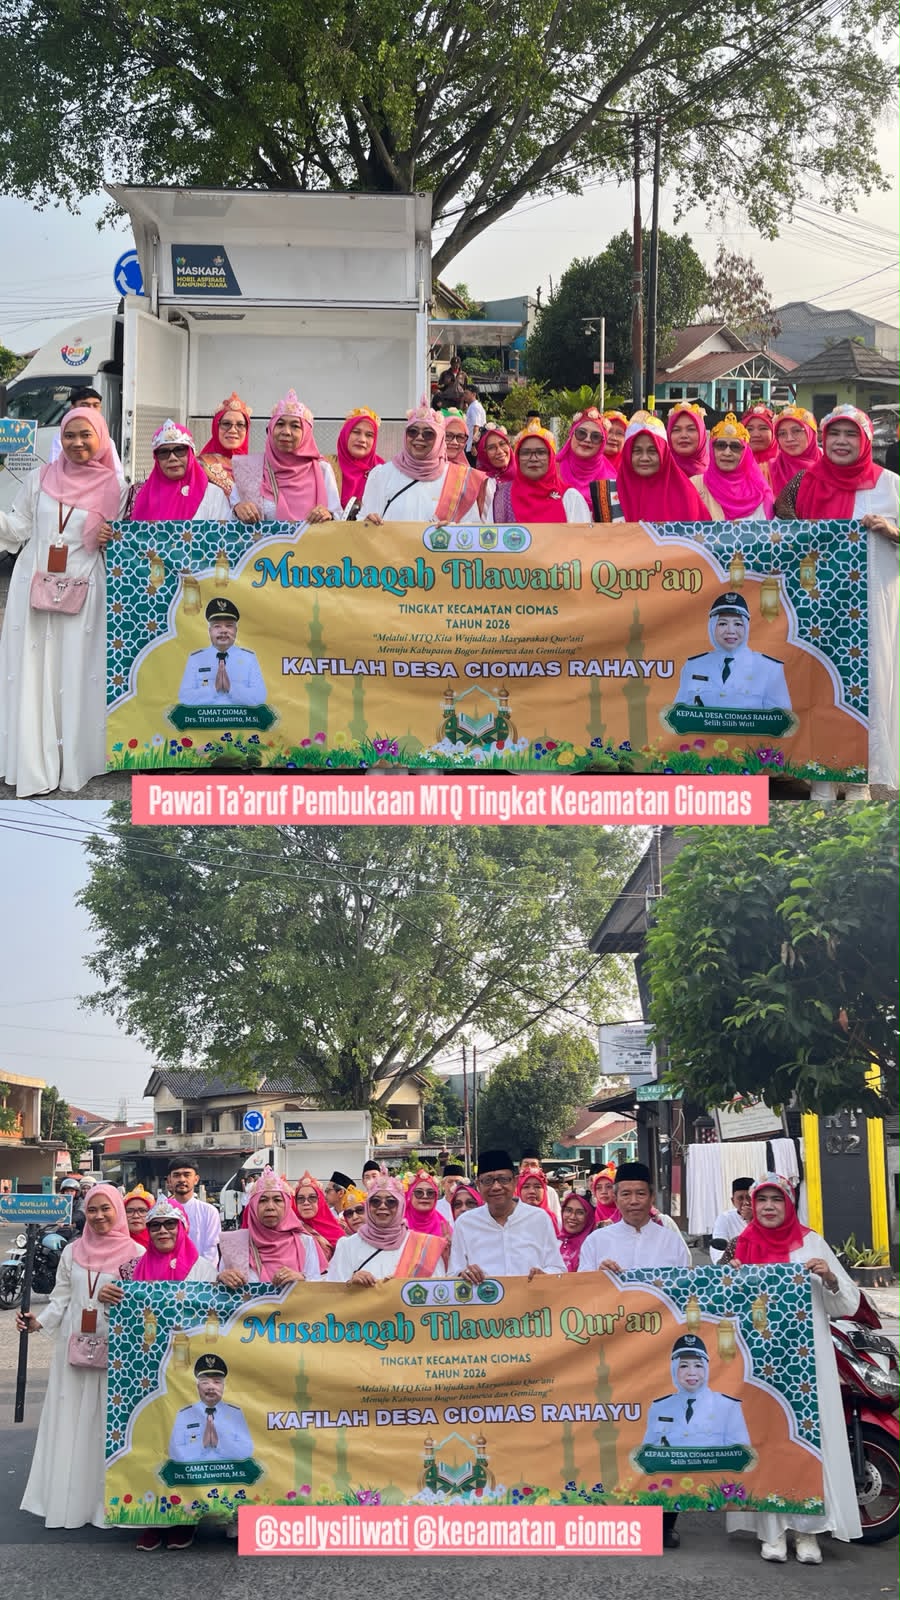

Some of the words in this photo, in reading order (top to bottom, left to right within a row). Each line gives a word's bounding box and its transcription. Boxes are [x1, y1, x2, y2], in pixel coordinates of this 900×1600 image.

[176, 266, 226, 276] MASKARA
[252, 551, 436, 597] Musabaqah
[442, 557, 582, 590] Tilawatil
[590, 560, 703, 600] Qur'an
[398, 604, 444, 614] TINGKAT
[447, 604, 512, 614] KECAMATAN
[515, 604, 559, 615] CIOMAS
[446, 618, 482, 629] TAHUN
[485, 620, 510, 630] 2026
[409, 634, 434, 644] MTQ
[434, 633, 452, 642] Kita
[455, 633, 498, 644] Wujudkan
[499, 634, 548, 646] Masyarakat
[378, 646, 408, 656] Menuju
[410, 646, 452, 656] Kabupaten
[454, 647, 480, 657] Bogor
[481, 647, 517, 656] Istimewa
[518, 647, 534, 656] dan
[282, 657, 386, 676] KAFILAH
[393, 660, 458, 678] DESA
[464, 660, 562, 678] CIOMAS
[568, 659, 674, 678] RAHAYU
[240, 1311, 415, 1350] Musabaqah
[420, 1306, 552, 1341] Tilawatil
[560, 1305, 662, 1344] Qur'an
[380, 1356, 424, 1366] TINGKAT
[426, 1354, 488, 1365] KECAMATAN
[490, 1353, 532, 1364] CIOMAS
[425, 1368, 460, 1378] TAHUN
[463, 1368, 487, 1378] 2026
[267, 1410, 370, 1430] KAFILAH
[376, 1408, 439, 1426] DESA
[444, 1404, 536, 1424] CIOMAS
[542, 1402, 642, 1422] RAHAYU
[209, 1464, 234, 1472] CIOMAS
